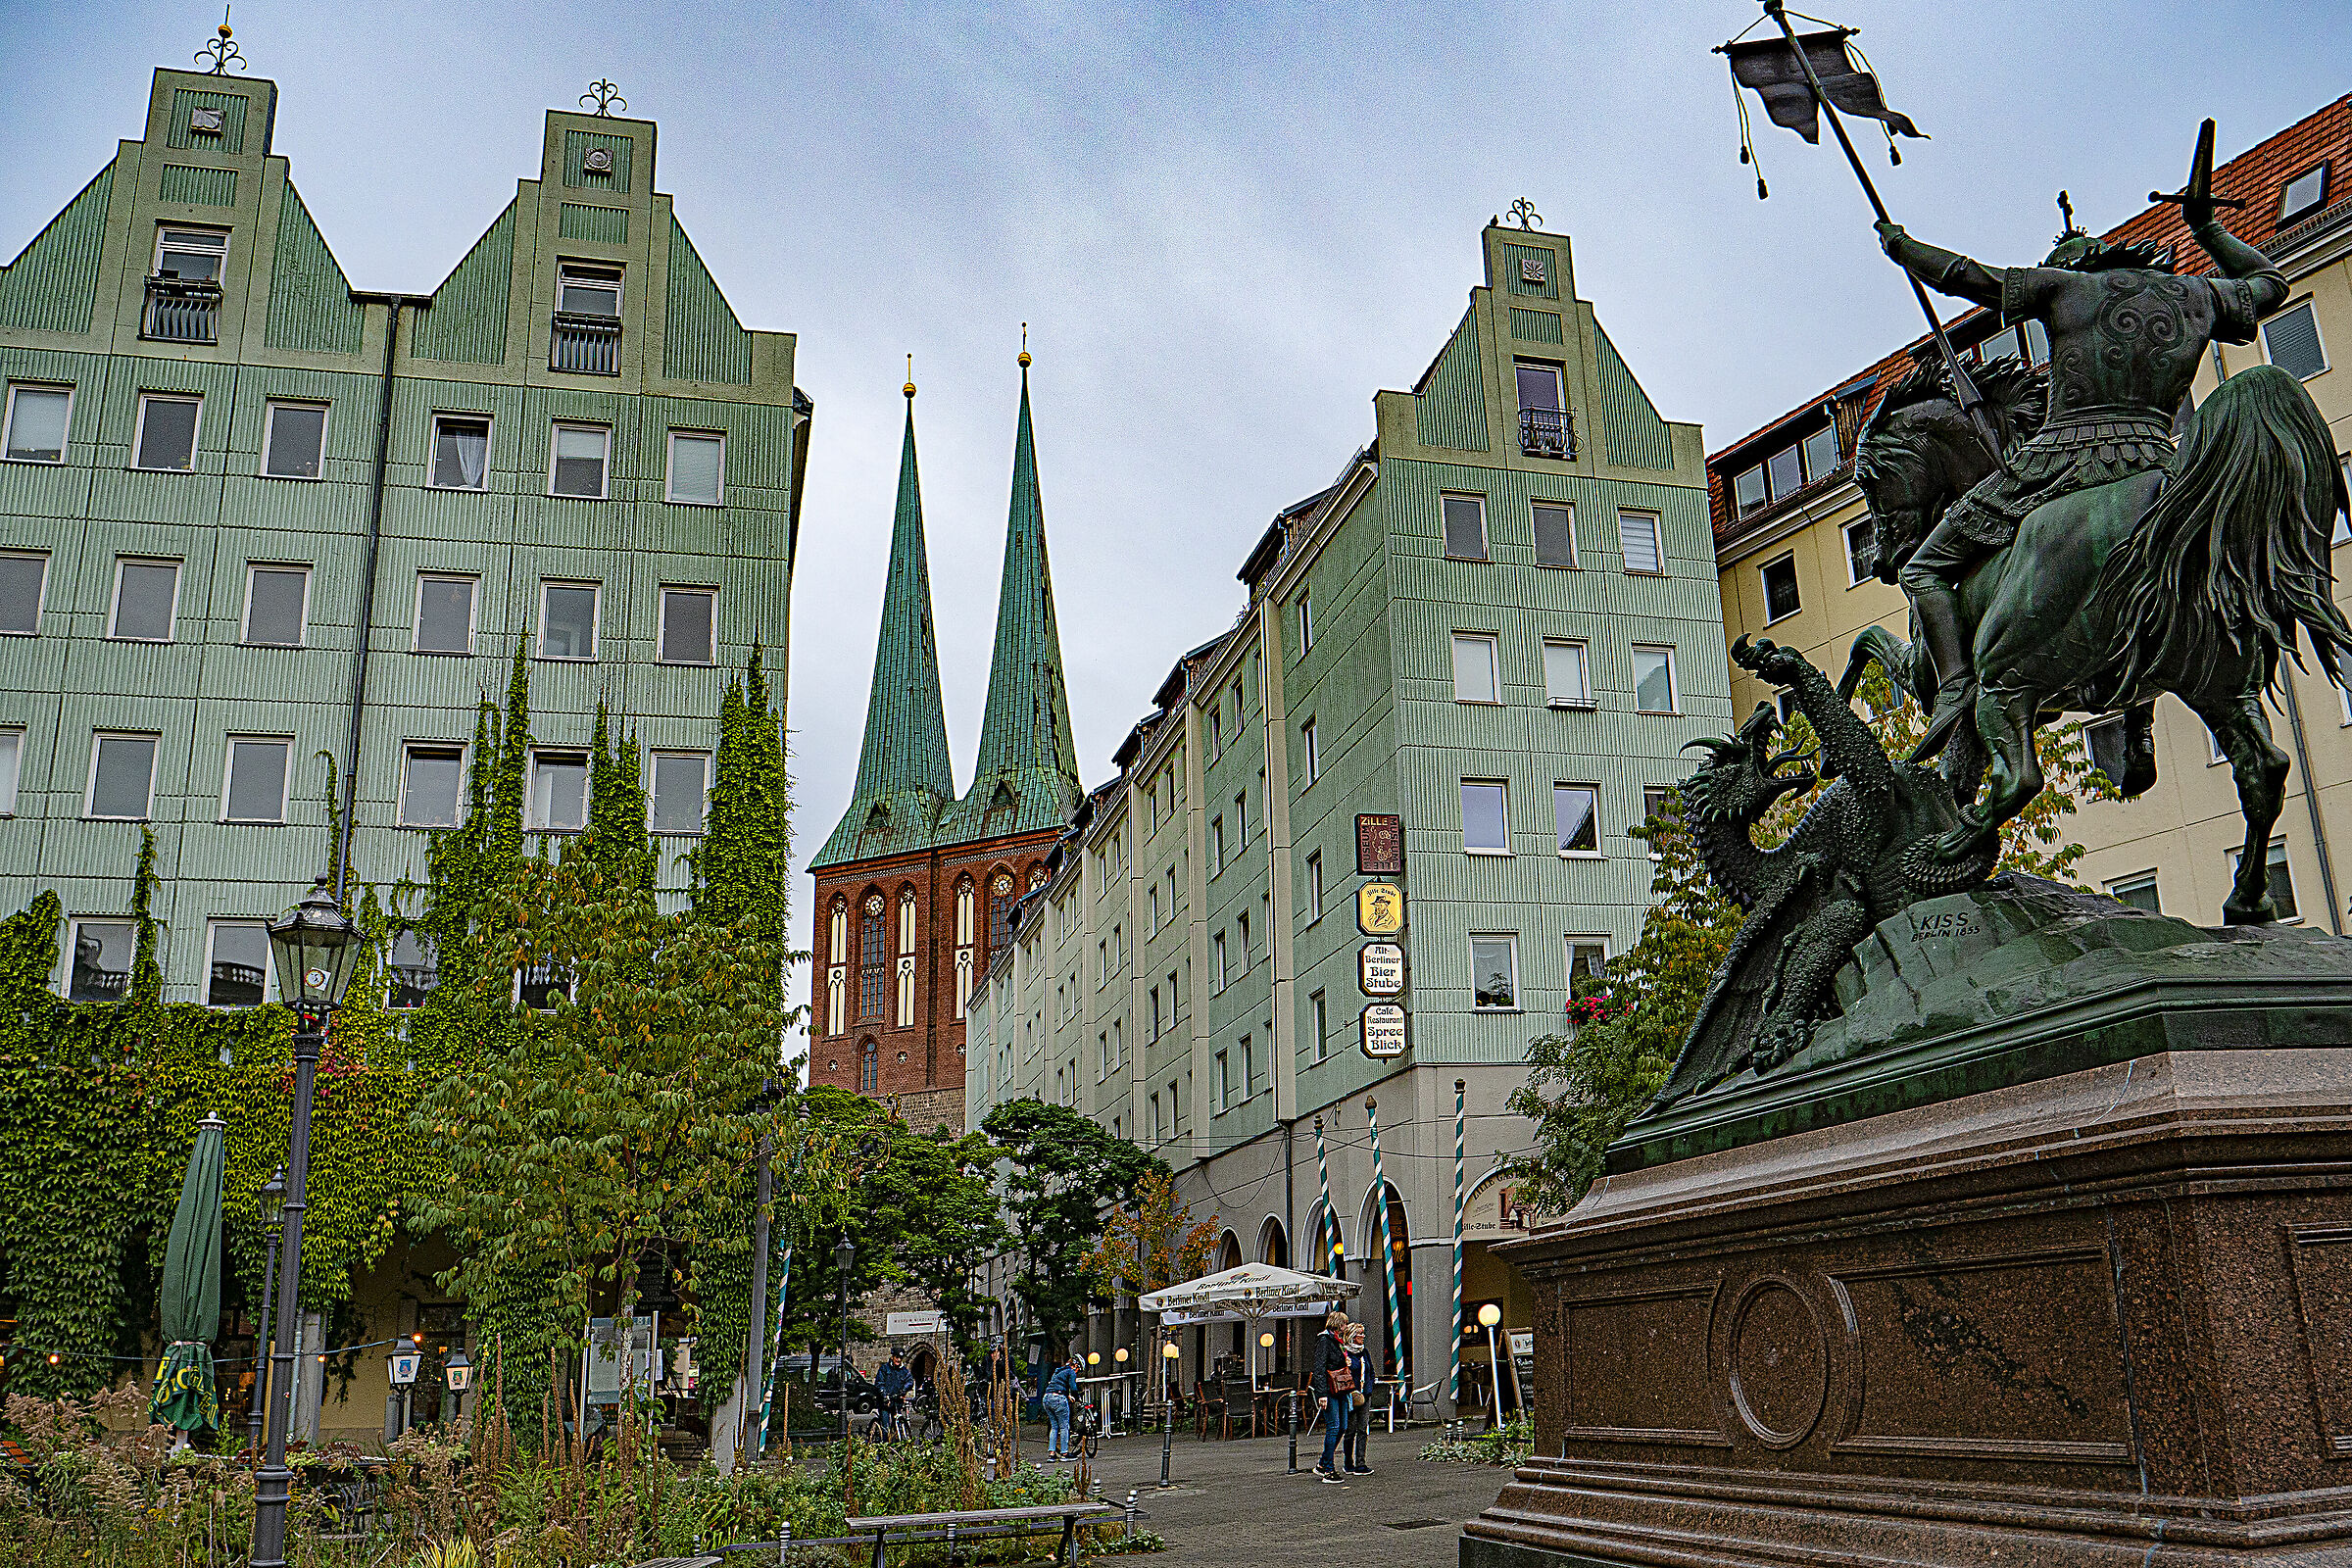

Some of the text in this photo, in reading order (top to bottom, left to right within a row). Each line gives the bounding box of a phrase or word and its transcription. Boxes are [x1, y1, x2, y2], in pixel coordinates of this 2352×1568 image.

[1390, 817, 1399, 861] MUSEUM
[1362, 826, 1371, 870] MUSEUM
[1920, 911, 1970, 931] KISS
[1910, 925, 1981, 943] BERLIN 1855
[1374, 946, 1391, 955] Alt-
[1364, 955, 1401, 964] Berliner
[1369, 966, 1396, 977] Bier
[1365, 977, 1401, 988] Stube
[1375, 1006, 1395, 1015] Café
[1366, 1015, 1403, 1024] Restaurant
[1367, 1026, 1403, 1040] Spree
[1370, 1039, 1402, 1051] Blick
[1463, 1222, 1496, 1231] ille-Stube
[1254, 1283, 1300, 1298] Berliner Kindl
[1166, 1291, 1210, 1306] Berliner Kindl
